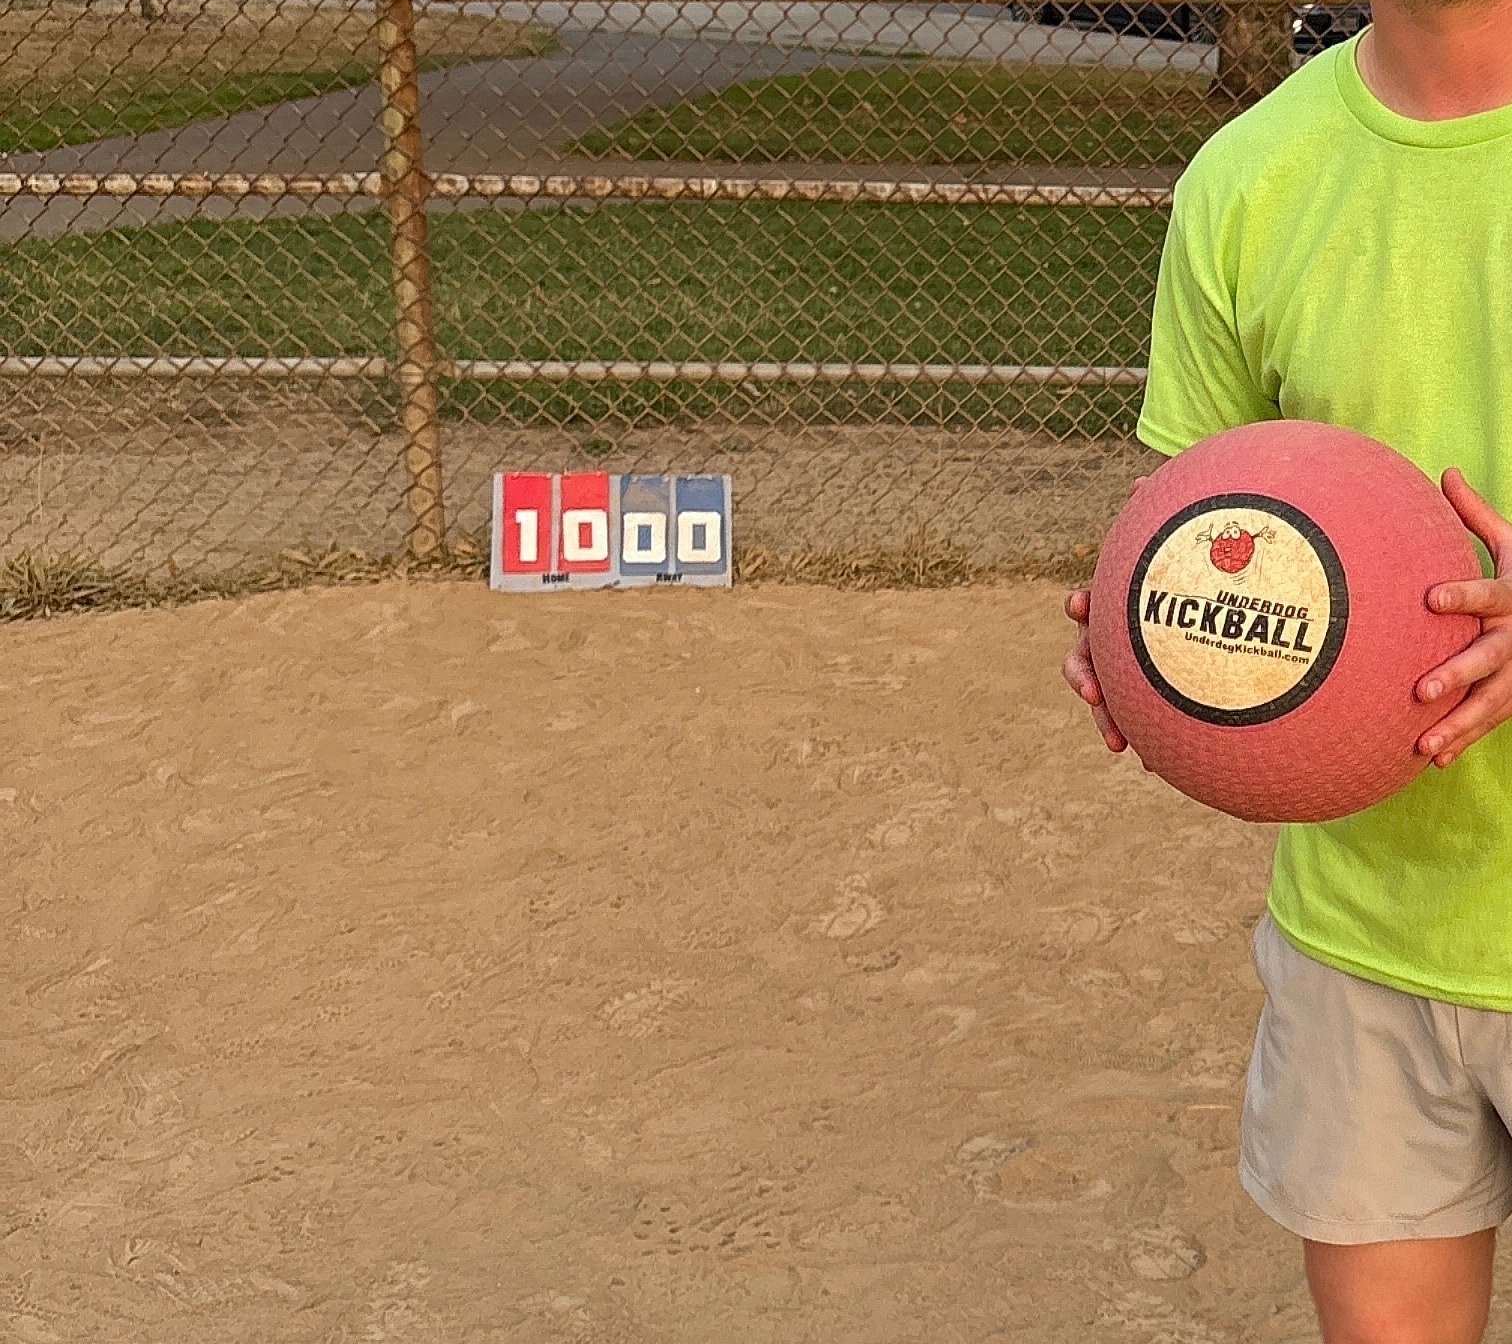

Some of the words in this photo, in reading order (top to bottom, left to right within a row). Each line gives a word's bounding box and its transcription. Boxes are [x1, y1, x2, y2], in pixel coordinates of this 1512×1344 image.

[541, 572, 570, 585] HOME
[655, 571, 683, 583] AWAY
[1216, 590, 1309, 619] UNDERDOG
[1144, 590, 1313, 653] KICKBALL
[1183, 631, 1311, 665] UnderdogKickball.com
